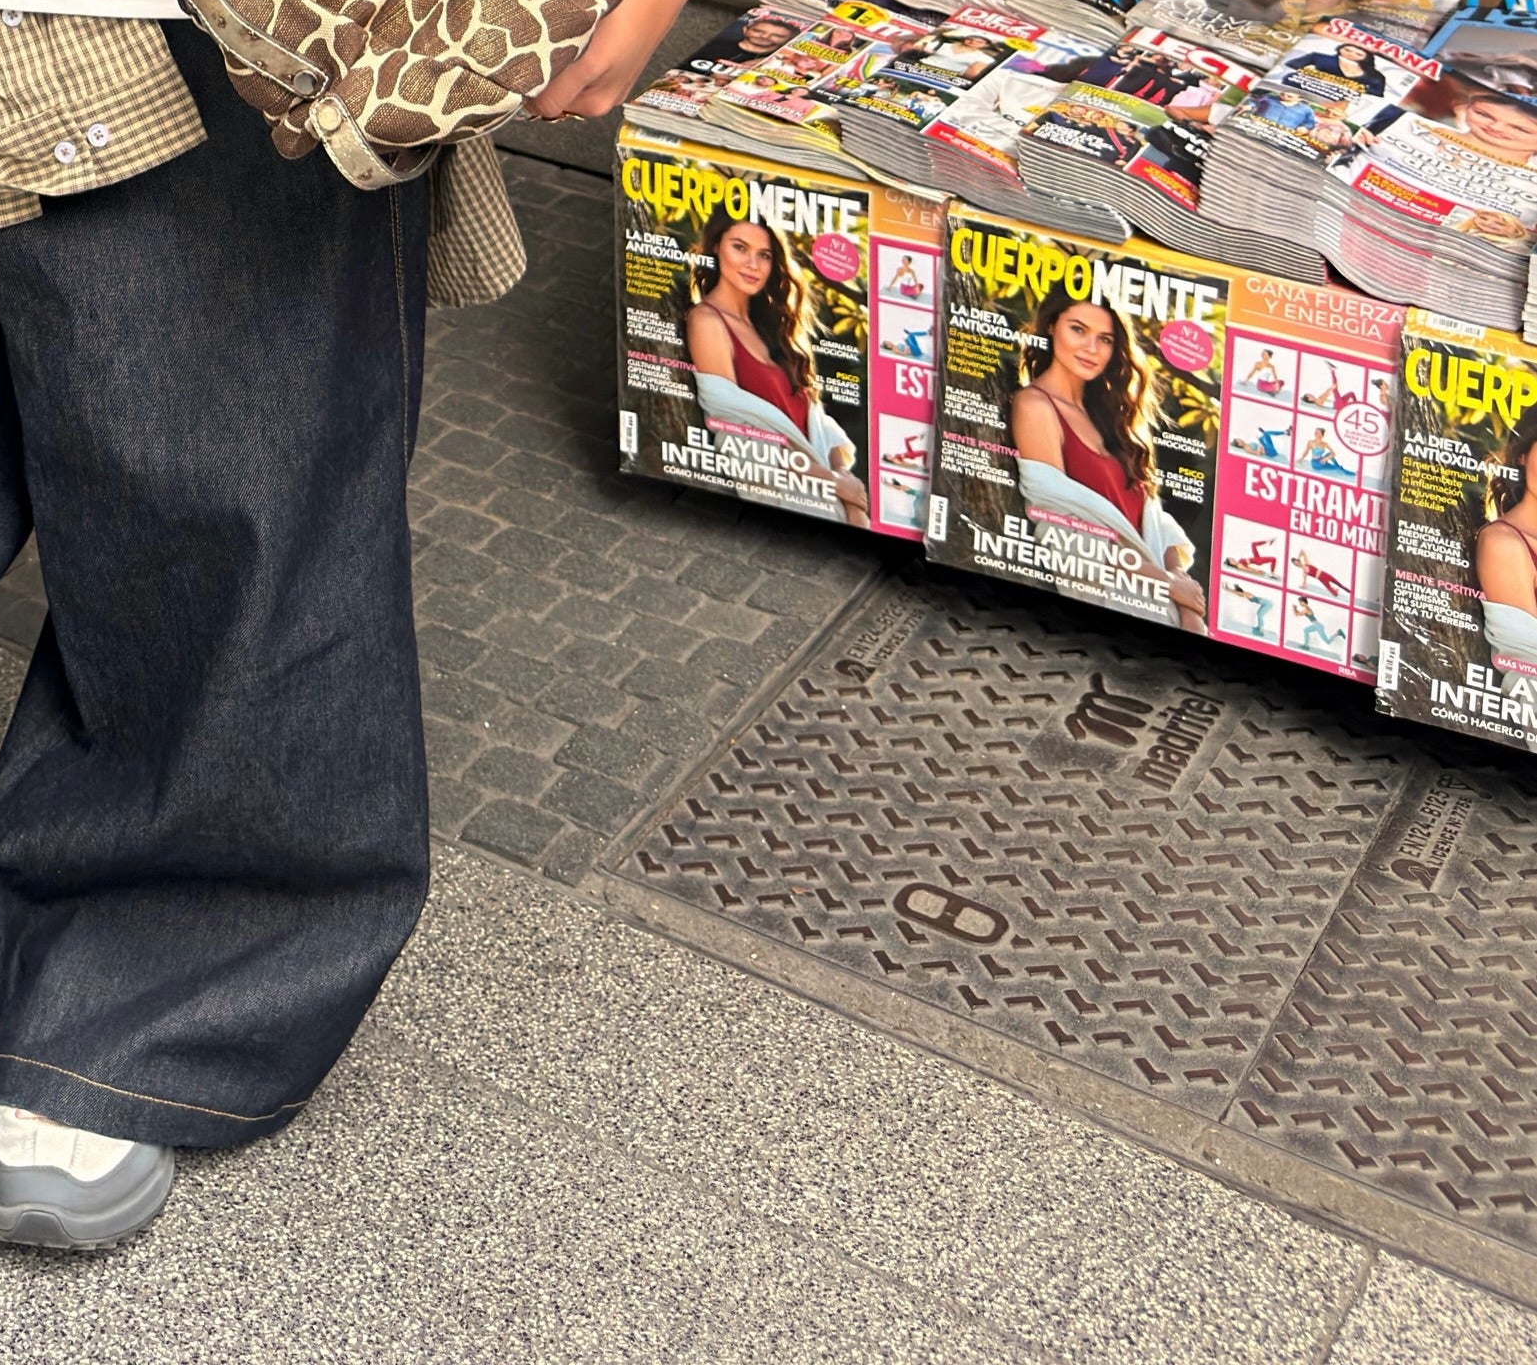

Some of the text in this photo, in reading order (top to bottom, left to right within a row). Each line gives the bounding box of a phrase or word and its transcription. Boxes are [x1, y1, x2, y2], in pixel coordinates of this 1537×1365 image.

[1325, 18, 1441, 79] SEMANA
[622, 157, 862, 244] CUERPOMENTE
[950, 227, 1221, 330] CUERPOMENTE
[1245, 277, 1402, 325] GANA FUERZA
[950, 315, 1048, 349] ANTIOXIDANTE
[1265, 298, 1383, 340] Y ENERGÍA
[1344, 409, 1379, 435] 45
[1405, 429, 1472, 455] LA DIETA
[662, 442, 836, 501] INTERMITENTE
[1403, 443, 1520, 481] ANTIOXIDANTE
[1290, 510, 1337, 539] EN 10
[1398, 519, 1441, 536] PLANTAS
[1398, 528, 1461, 550] MEDICINALES
[1004, 514, 1142, 570] EL AYUNO
[1405, 546, 1442, 563] PERDER
[1420, 540, 1460, 557] AYUDAN
[973, 530, 1170, 602] INTERMITENTE
[1396, 569, 1487, 601] MENTE POSITIVA
[1436, 612, 1479, 632] CEREBRO
[1431, 707, 1524, 739] CÓMO HACERLO
